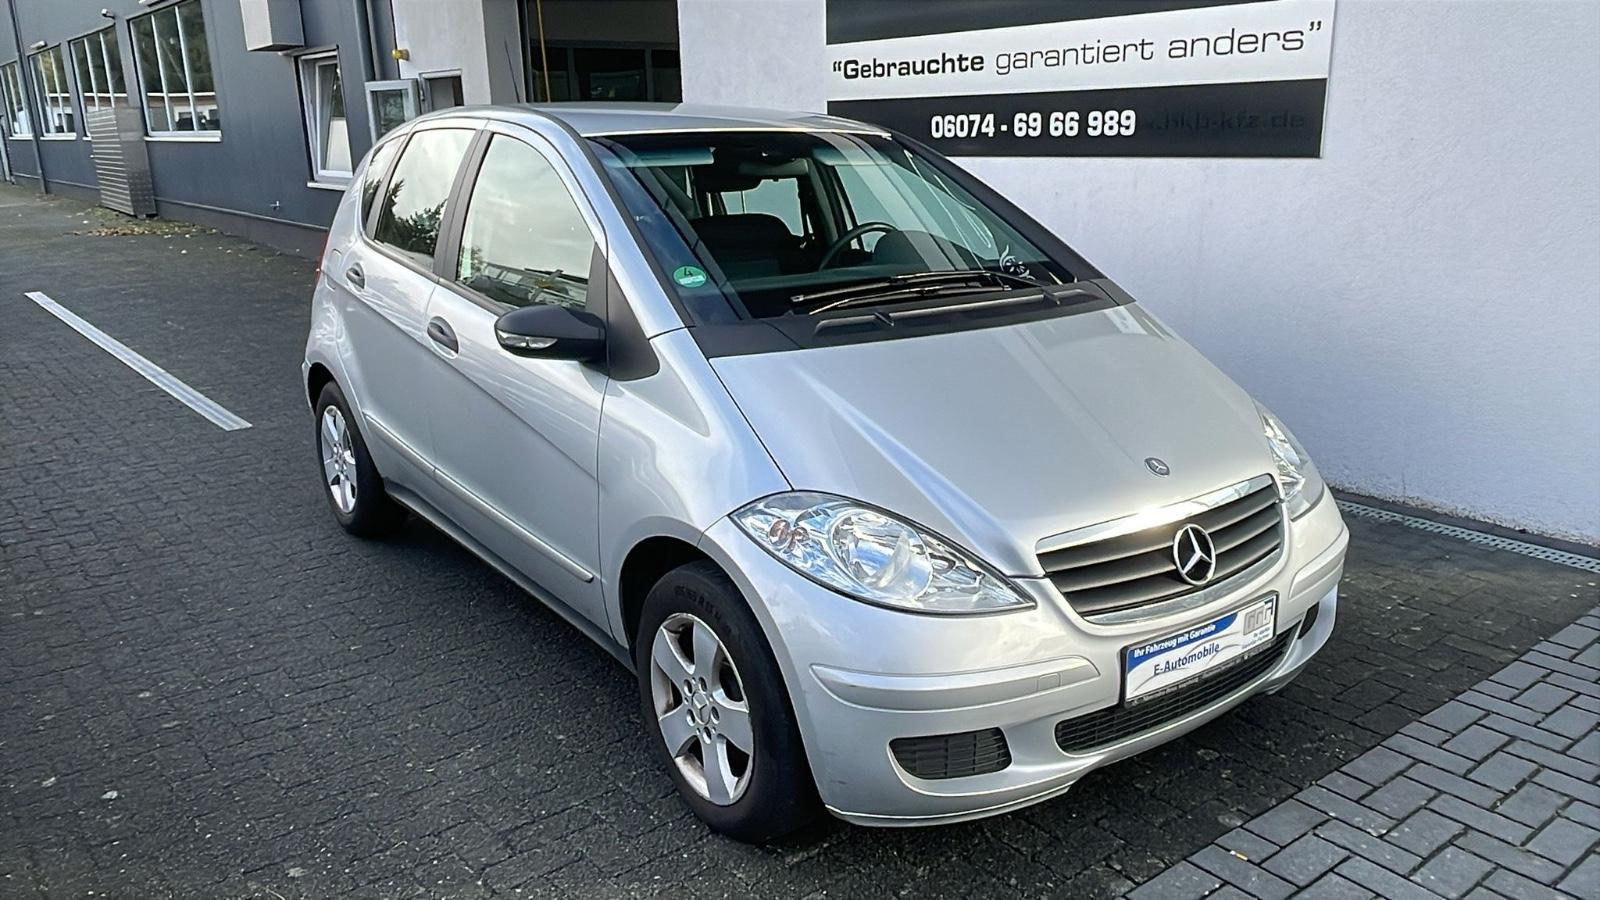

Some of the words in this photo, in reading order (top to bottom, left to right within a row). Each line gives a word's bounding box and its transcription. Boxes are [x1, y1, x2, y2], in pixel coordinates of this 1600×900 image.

[832, 52, 985, 80] “Gebrauchte
[996, 38, 1155, 76] garantiert
[1167, 20, 1323, 60] anders”
[931, 113, 995, 139] 06074
[1013, 112, 1043, 138] 69
[1049, 111, 1080, 137] 66
[1087, 110, 1136, 137] 989
[1133, 648, 1145, 658] Ihr
[1145, 638, 1177, 654] Fahrzeug
[1177, 633, 1190, 644] mit
[1189, 623, 1216, 640] Garantie
[1153, 642, 1220, 676] E-Automobile
